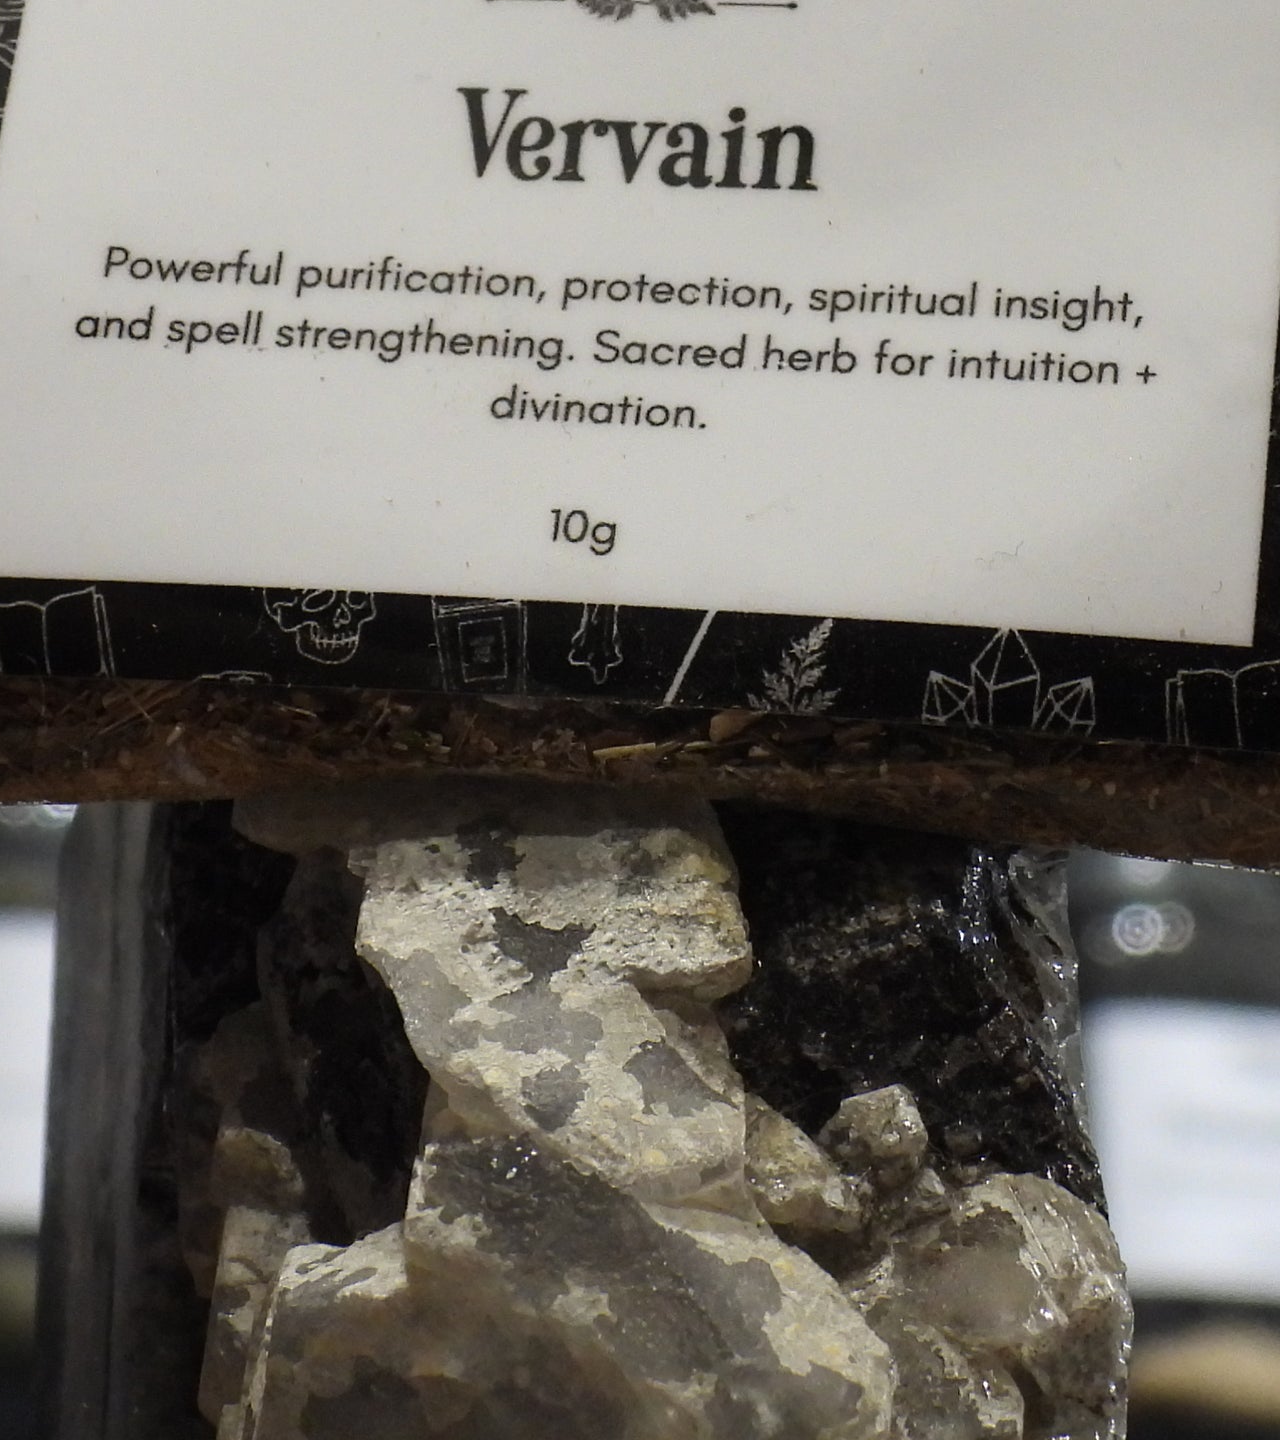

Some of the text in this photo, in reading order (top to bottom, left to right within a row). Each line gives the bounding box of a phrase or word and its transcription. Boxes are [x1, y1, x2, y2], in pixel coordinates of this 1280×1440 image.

[456, 87, 818, 192] Vervain
[103, 246, 1143, 332] Powerful purification, protection, spiritual insight,
[75, 305, 1157, 385] and spell strengthening. Sacred herb for intuition +
[490, 383, 706, 429] divination.
[551, 509, 617, 556] 10g
